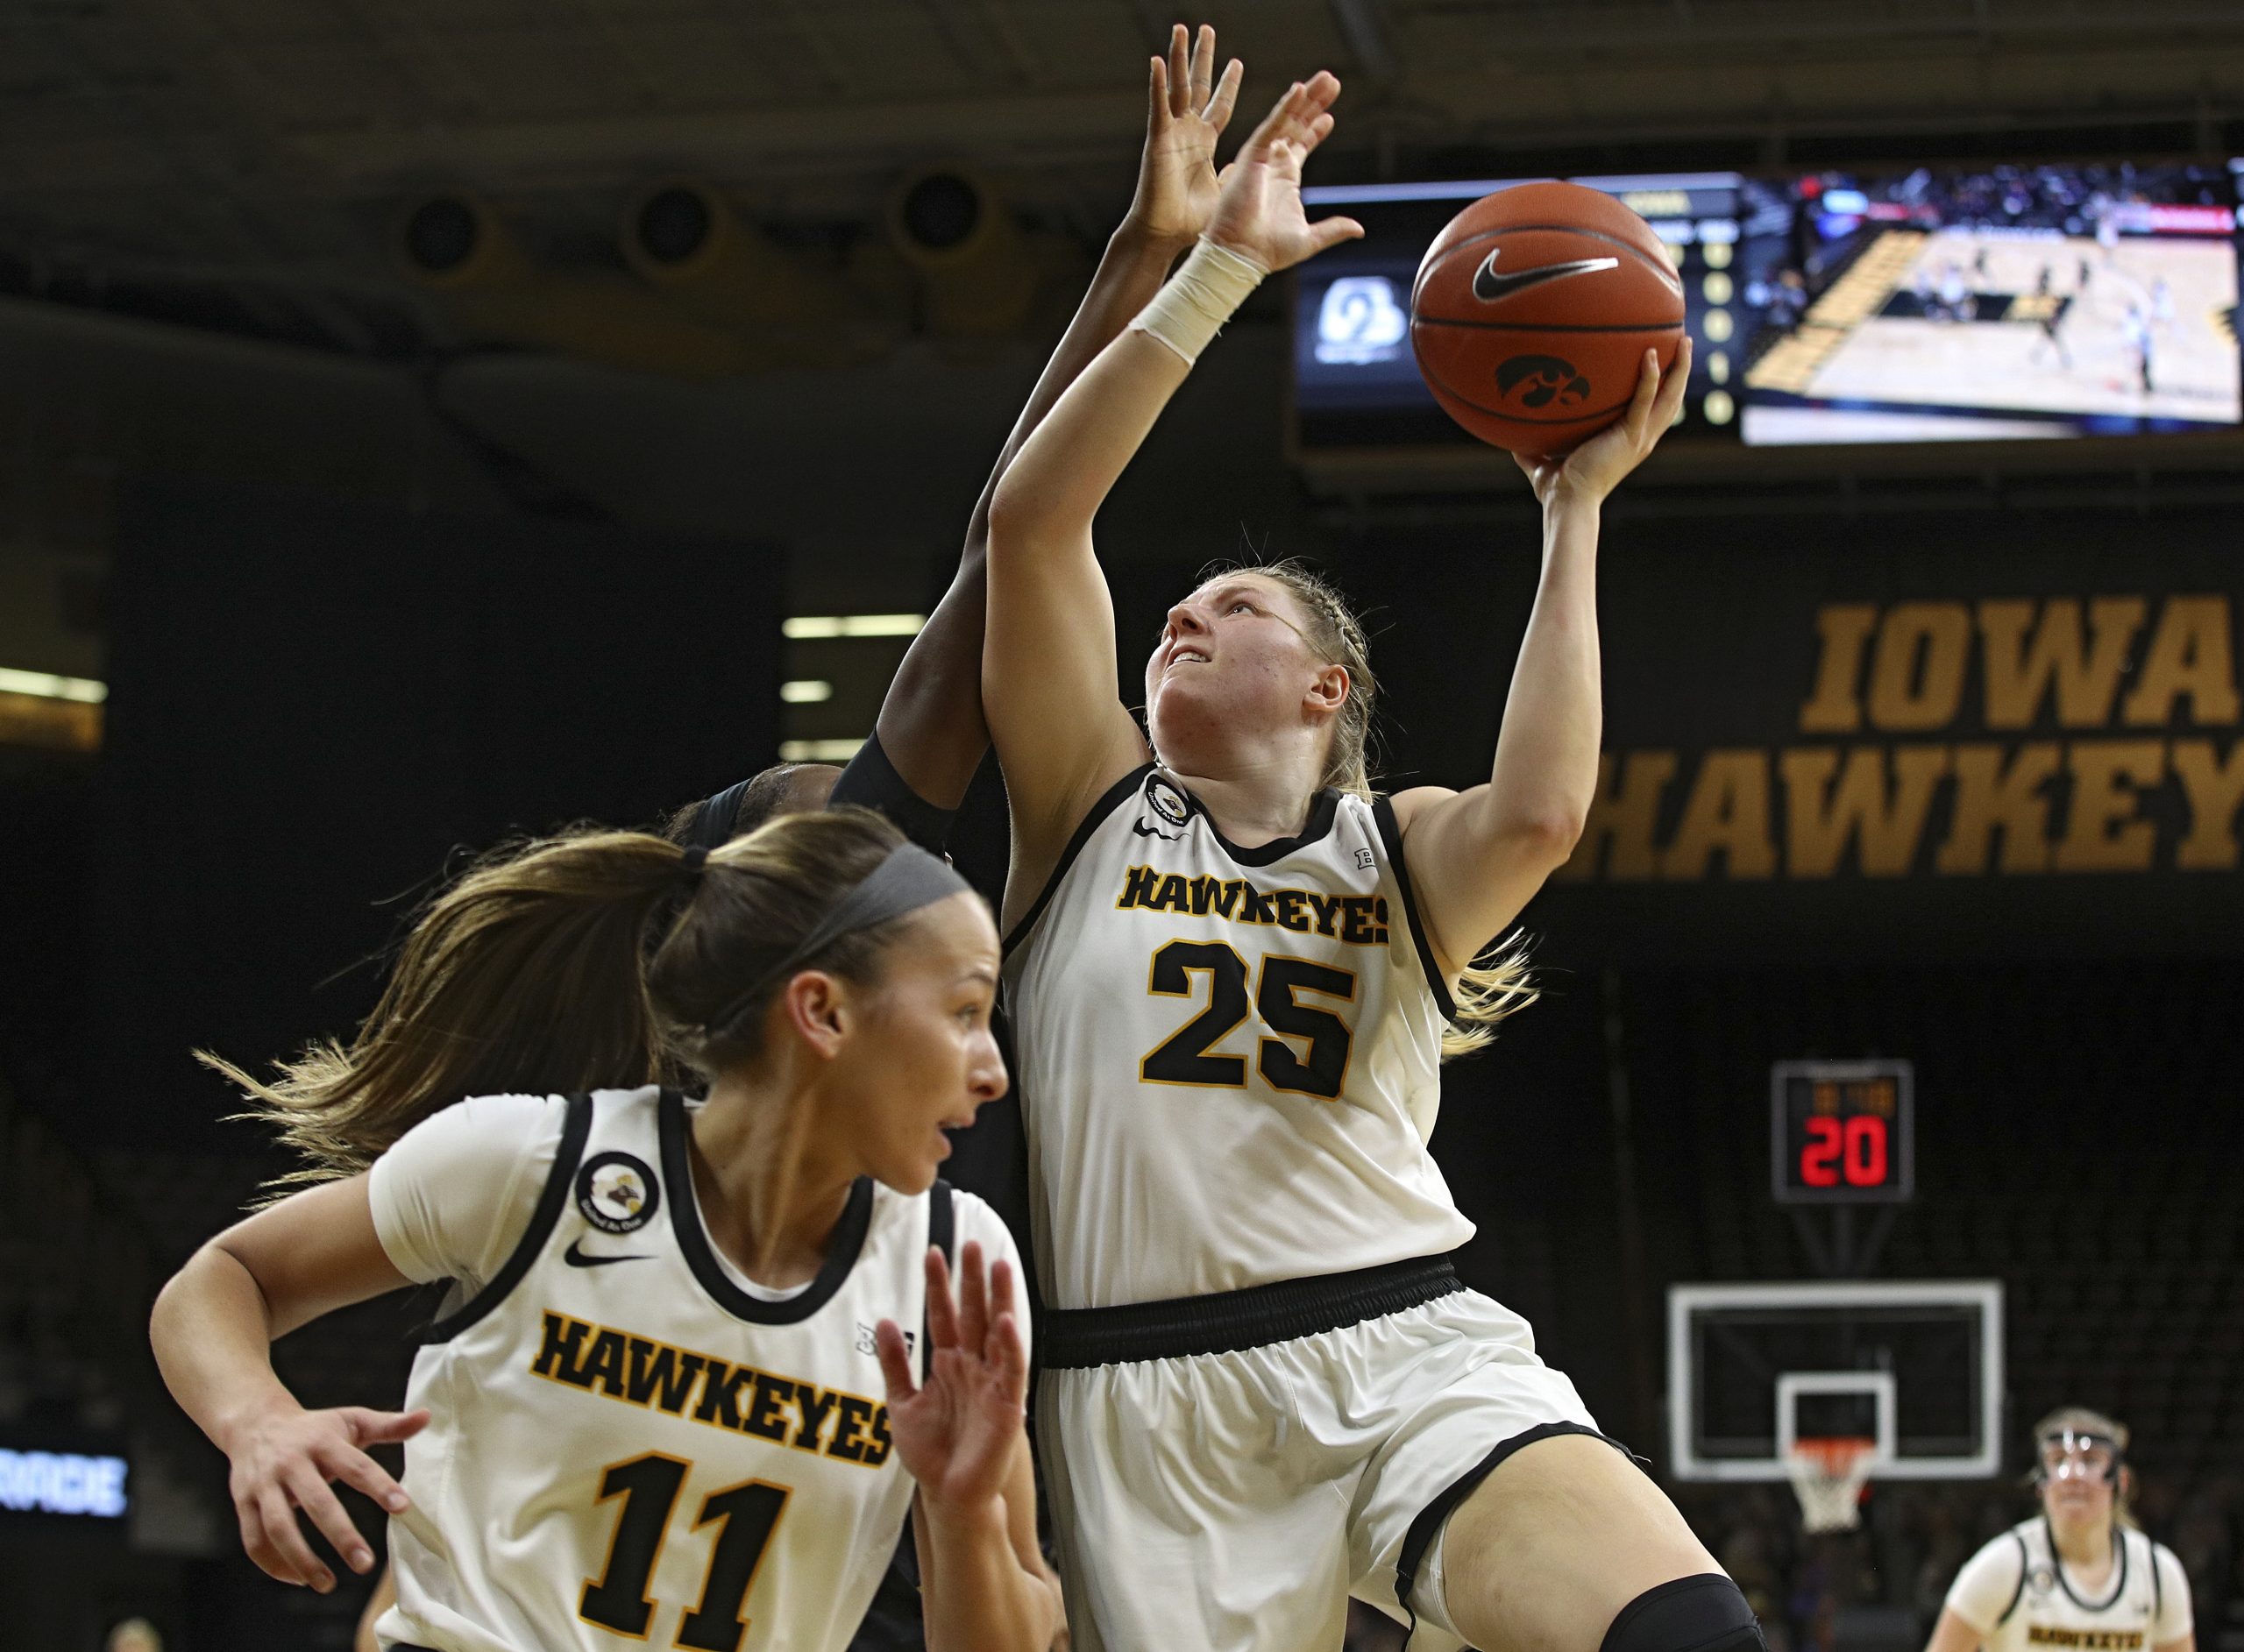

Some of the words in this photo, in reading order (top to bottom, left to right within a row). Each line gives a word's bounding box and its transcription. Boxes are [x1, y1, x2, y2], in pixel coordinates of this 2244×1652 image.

[1798, 595, 2242, 734] IOWA
[1139, 937, 1357, 1103] 25
[1800, 1115, 1888, 1188] 20
[578, 1450, 793, 1652] 11
